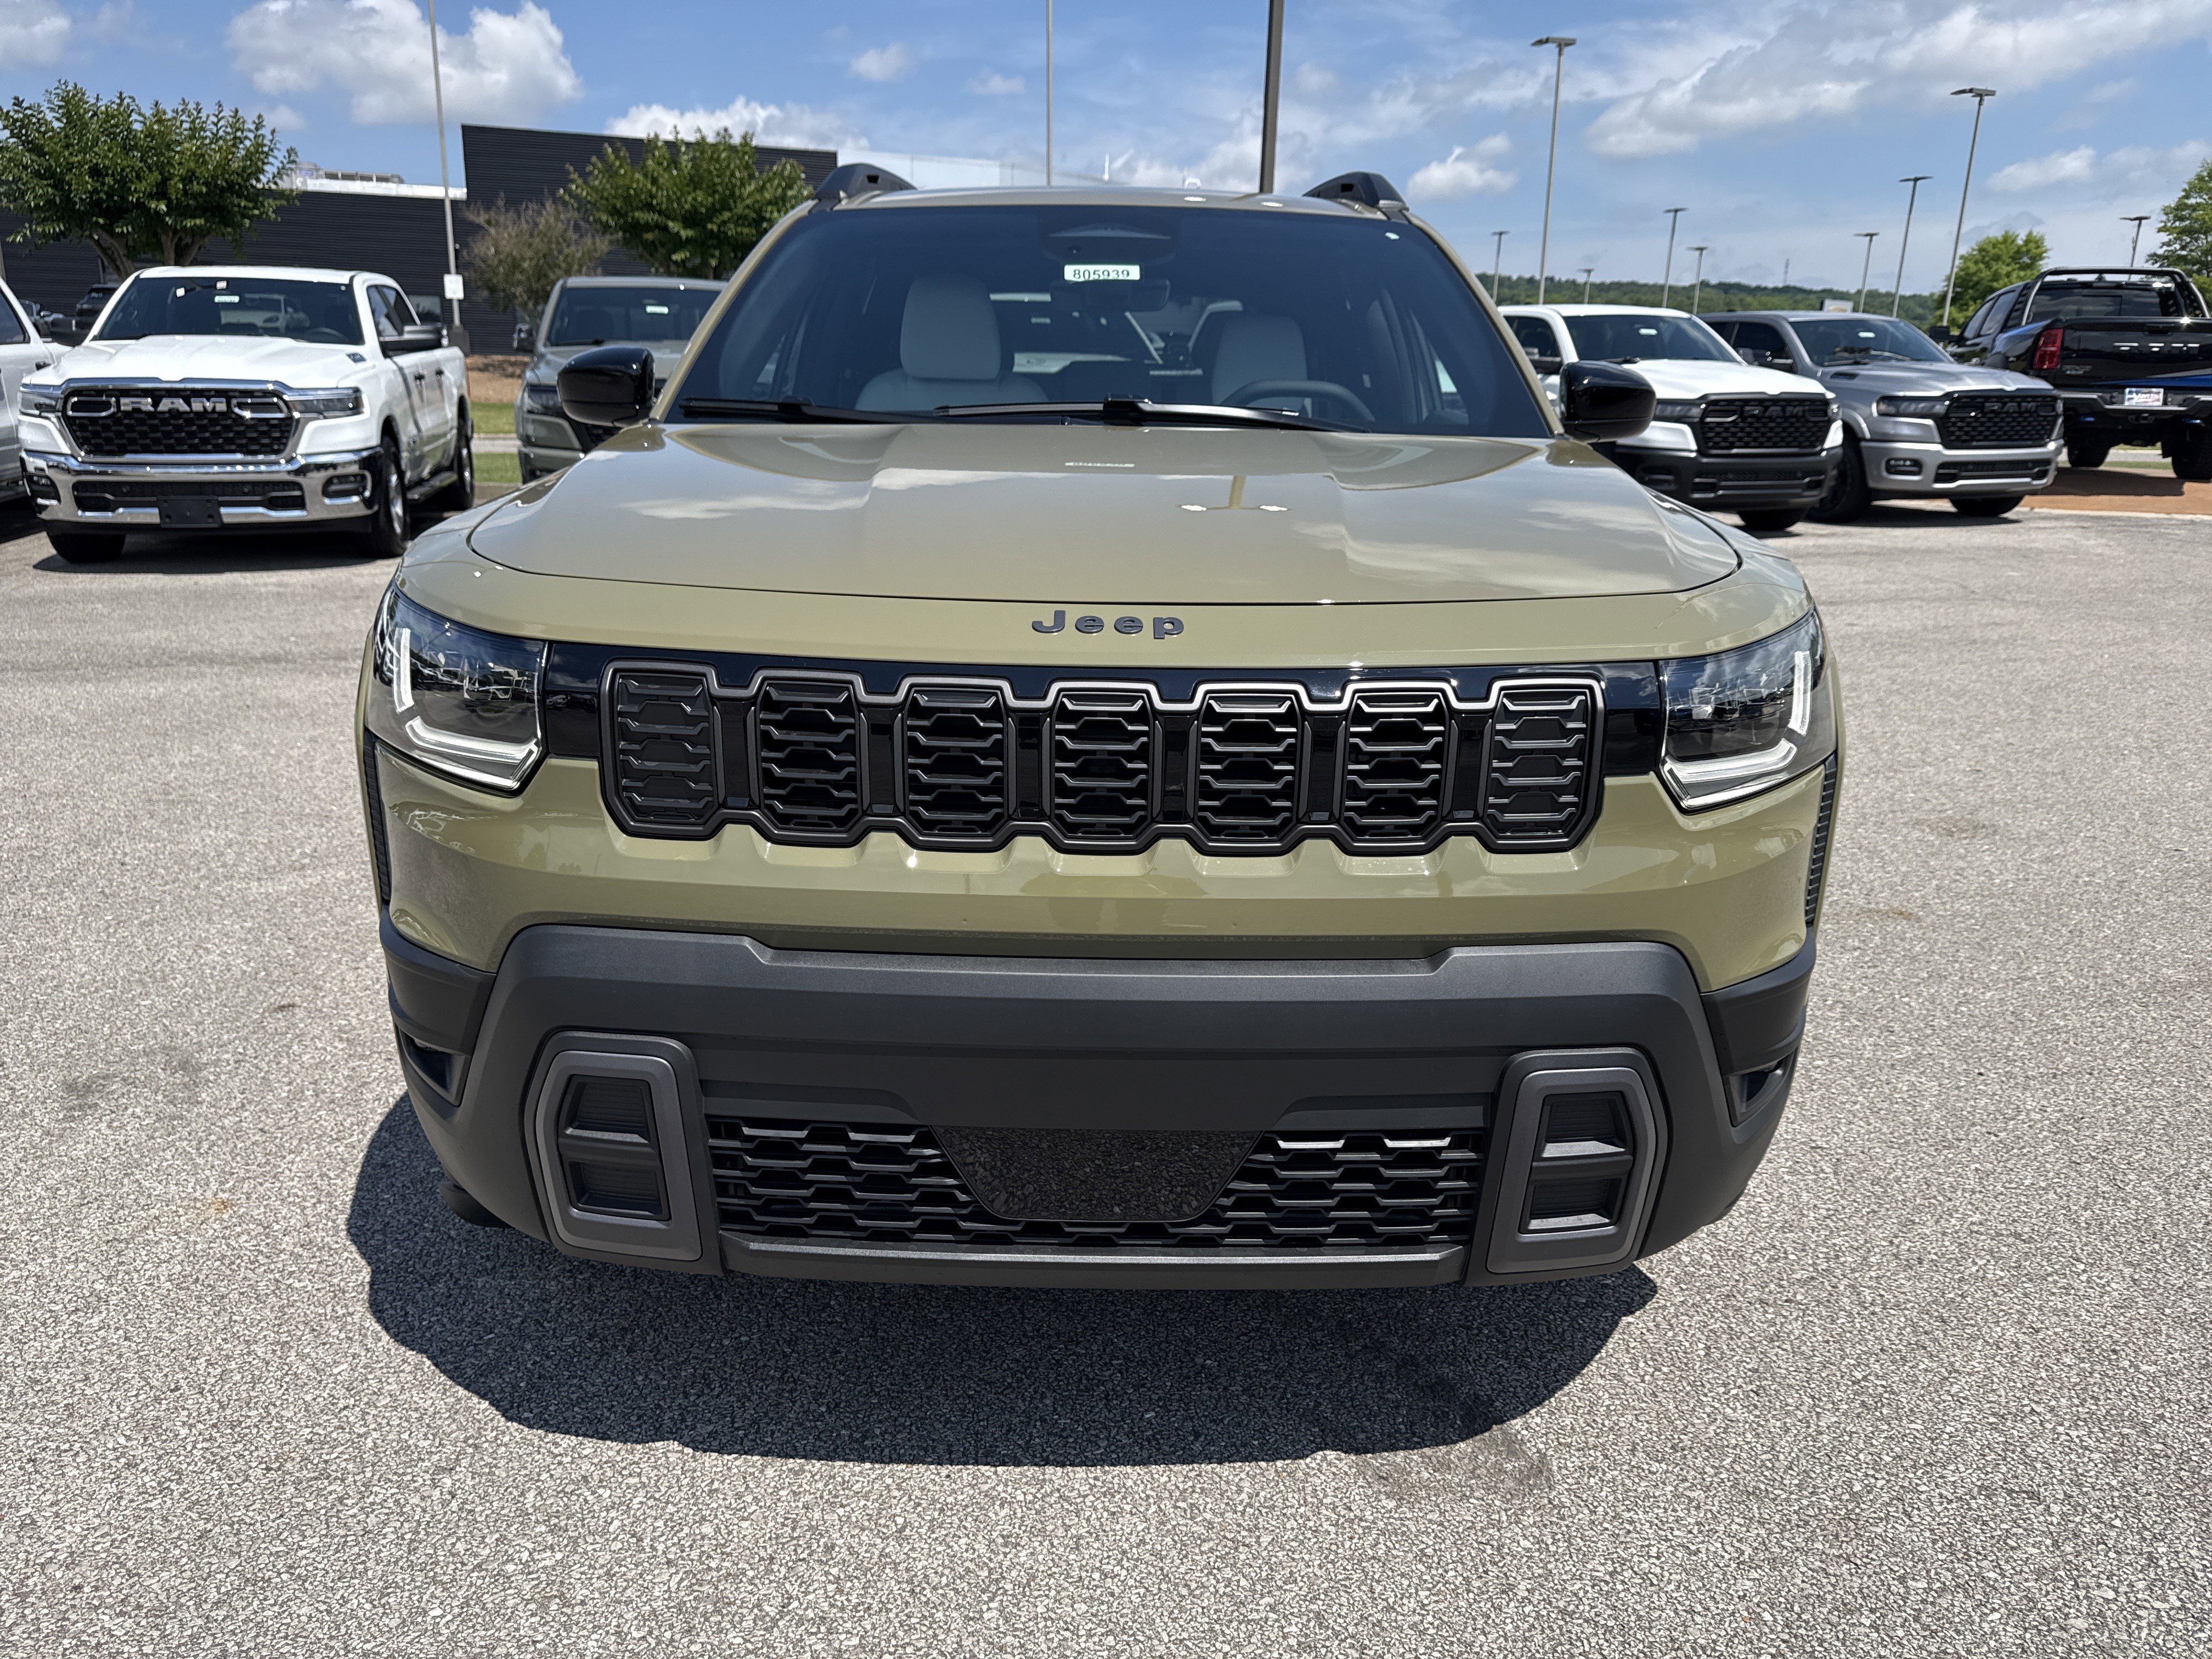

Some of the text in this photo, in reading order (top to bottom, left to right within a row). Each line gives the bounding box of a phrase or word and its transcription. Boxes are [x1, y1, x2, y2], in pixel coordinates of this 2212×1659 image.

[1073, 268, 1130, 280] 805939
[120, 397, 228, 412] RAM
[1031, 610, 1184, 640] Jeep
